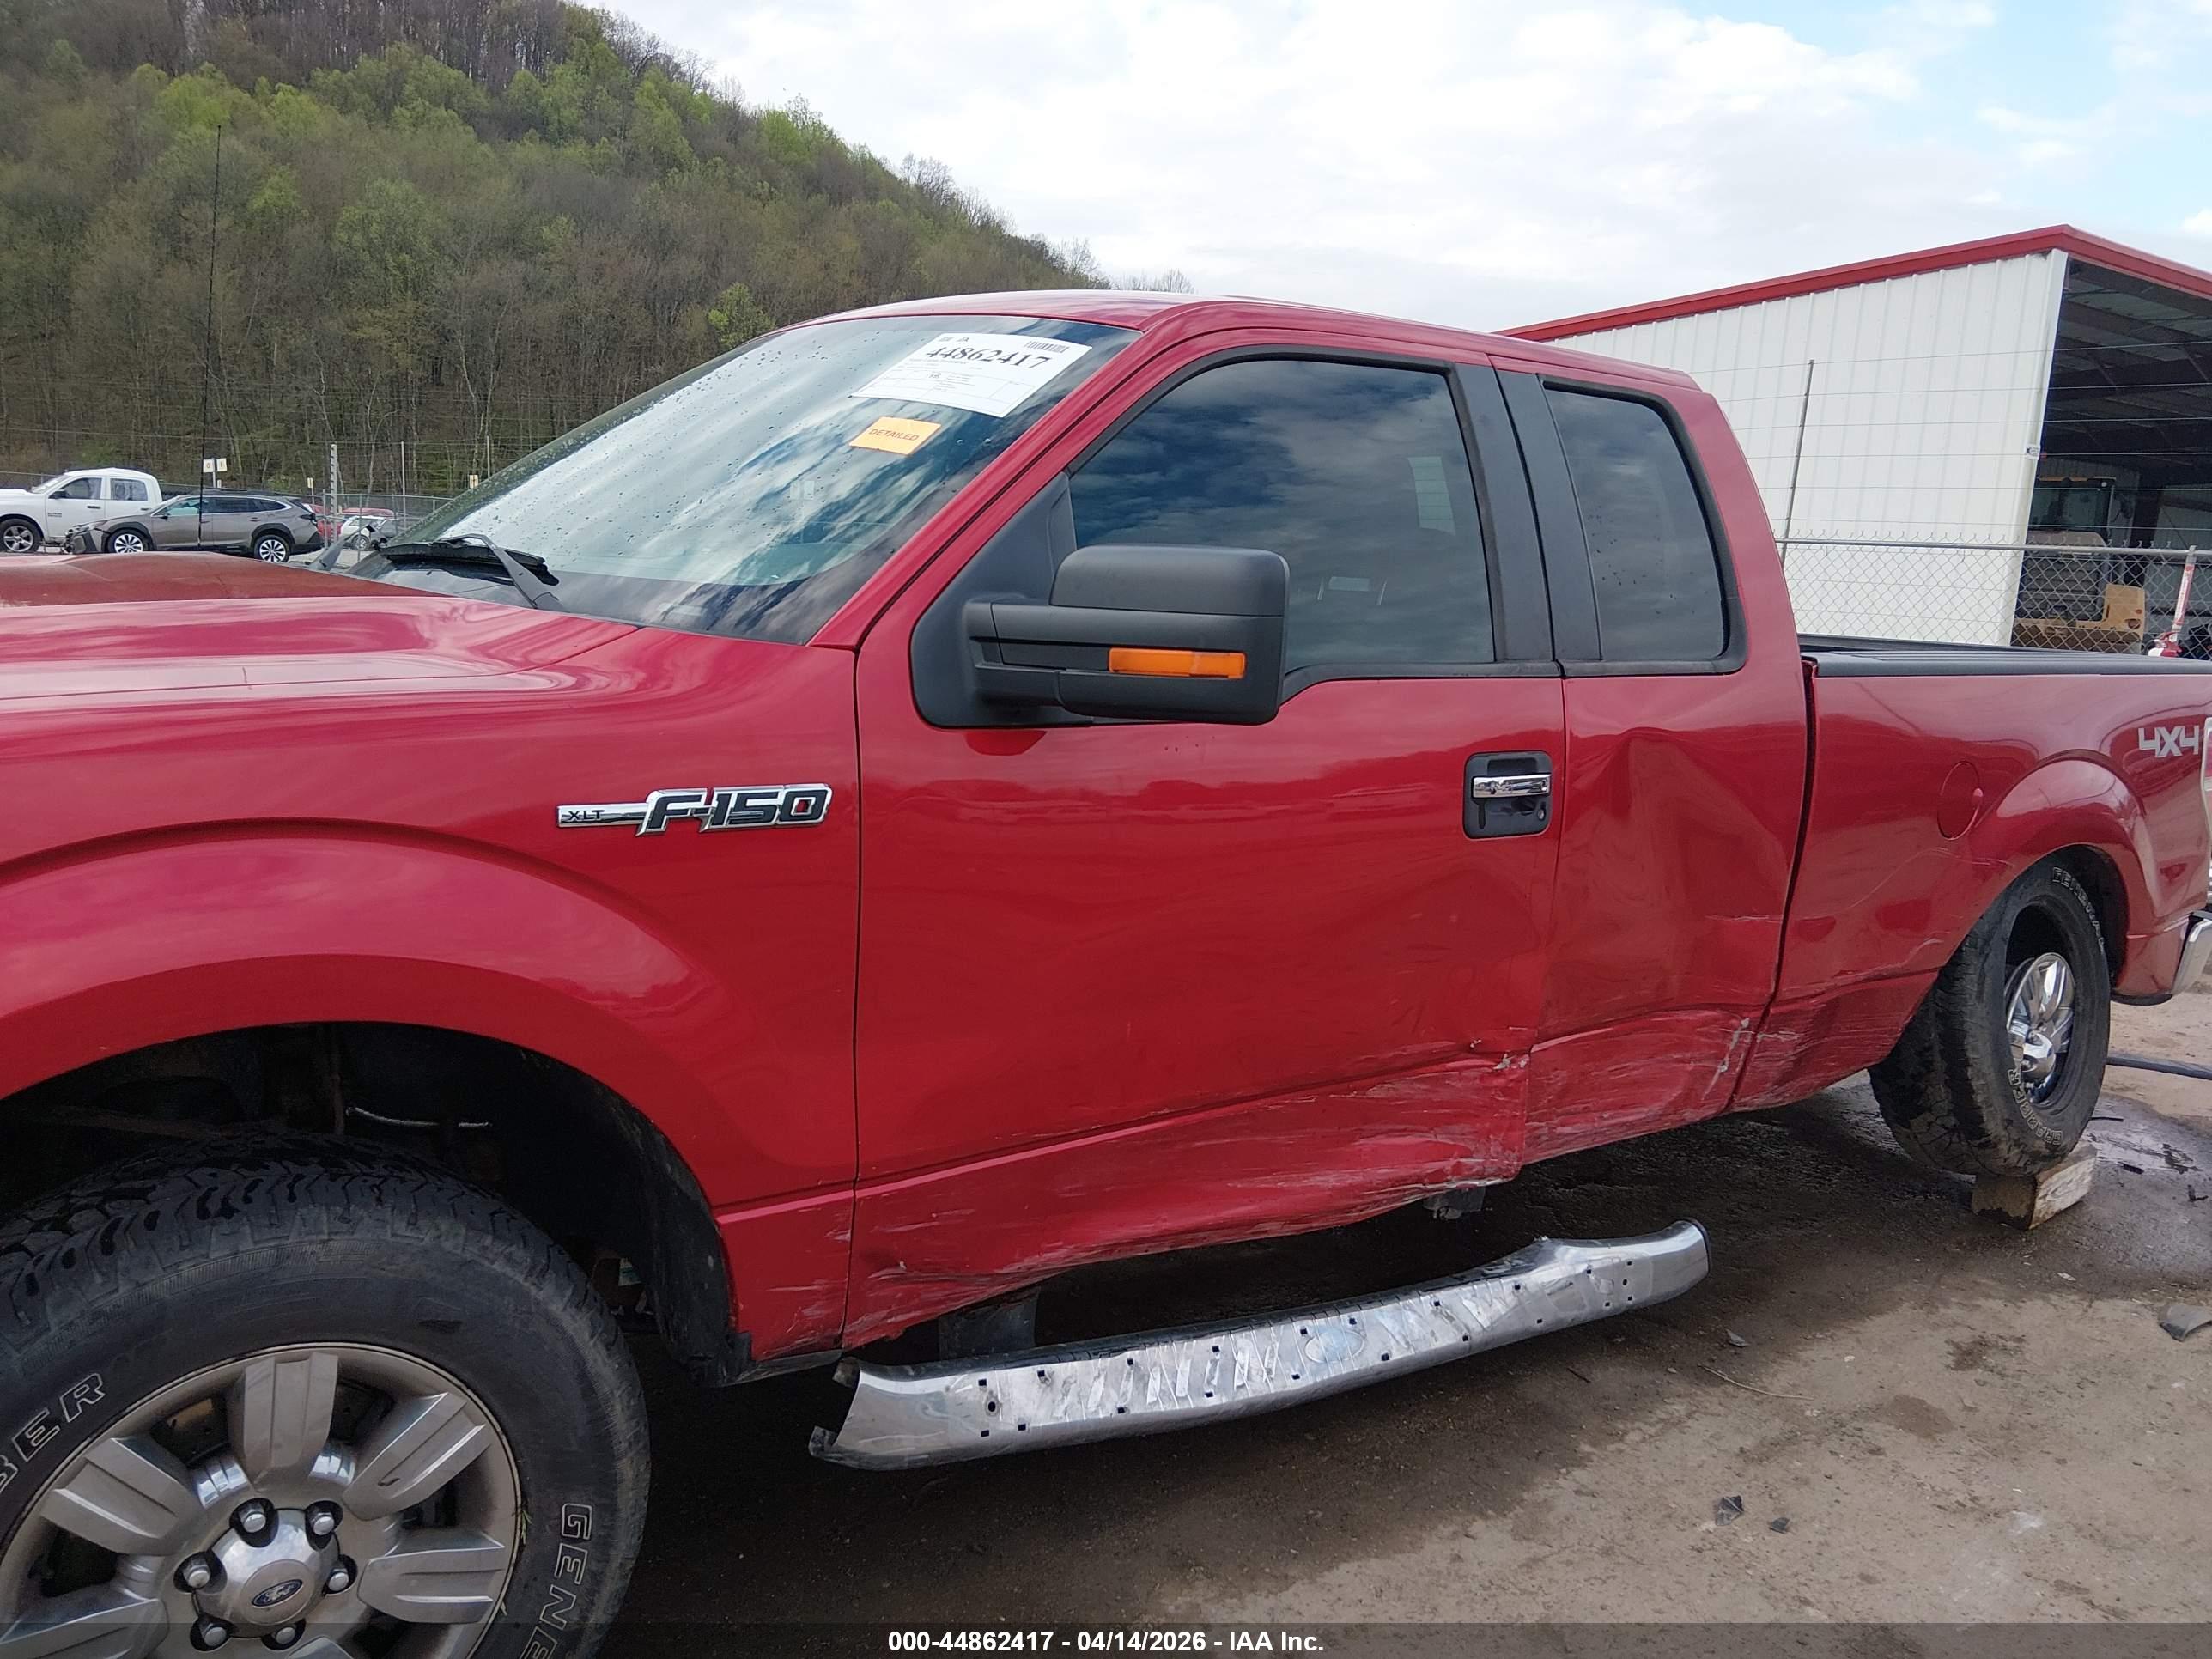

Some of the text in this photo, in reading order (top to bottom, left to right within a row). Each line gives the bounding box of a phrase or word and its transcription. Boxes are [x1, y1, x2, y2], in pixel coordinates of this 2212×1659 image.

[925, 346, 1054, 369] 44862417
[868, 428, 920, 441] DETAILED
[2137, 725, 2200, 757] 4X4
[567, 783, 833, 836] XLT F-150
[2007, 1068, 2063, 1146] GRABBER
